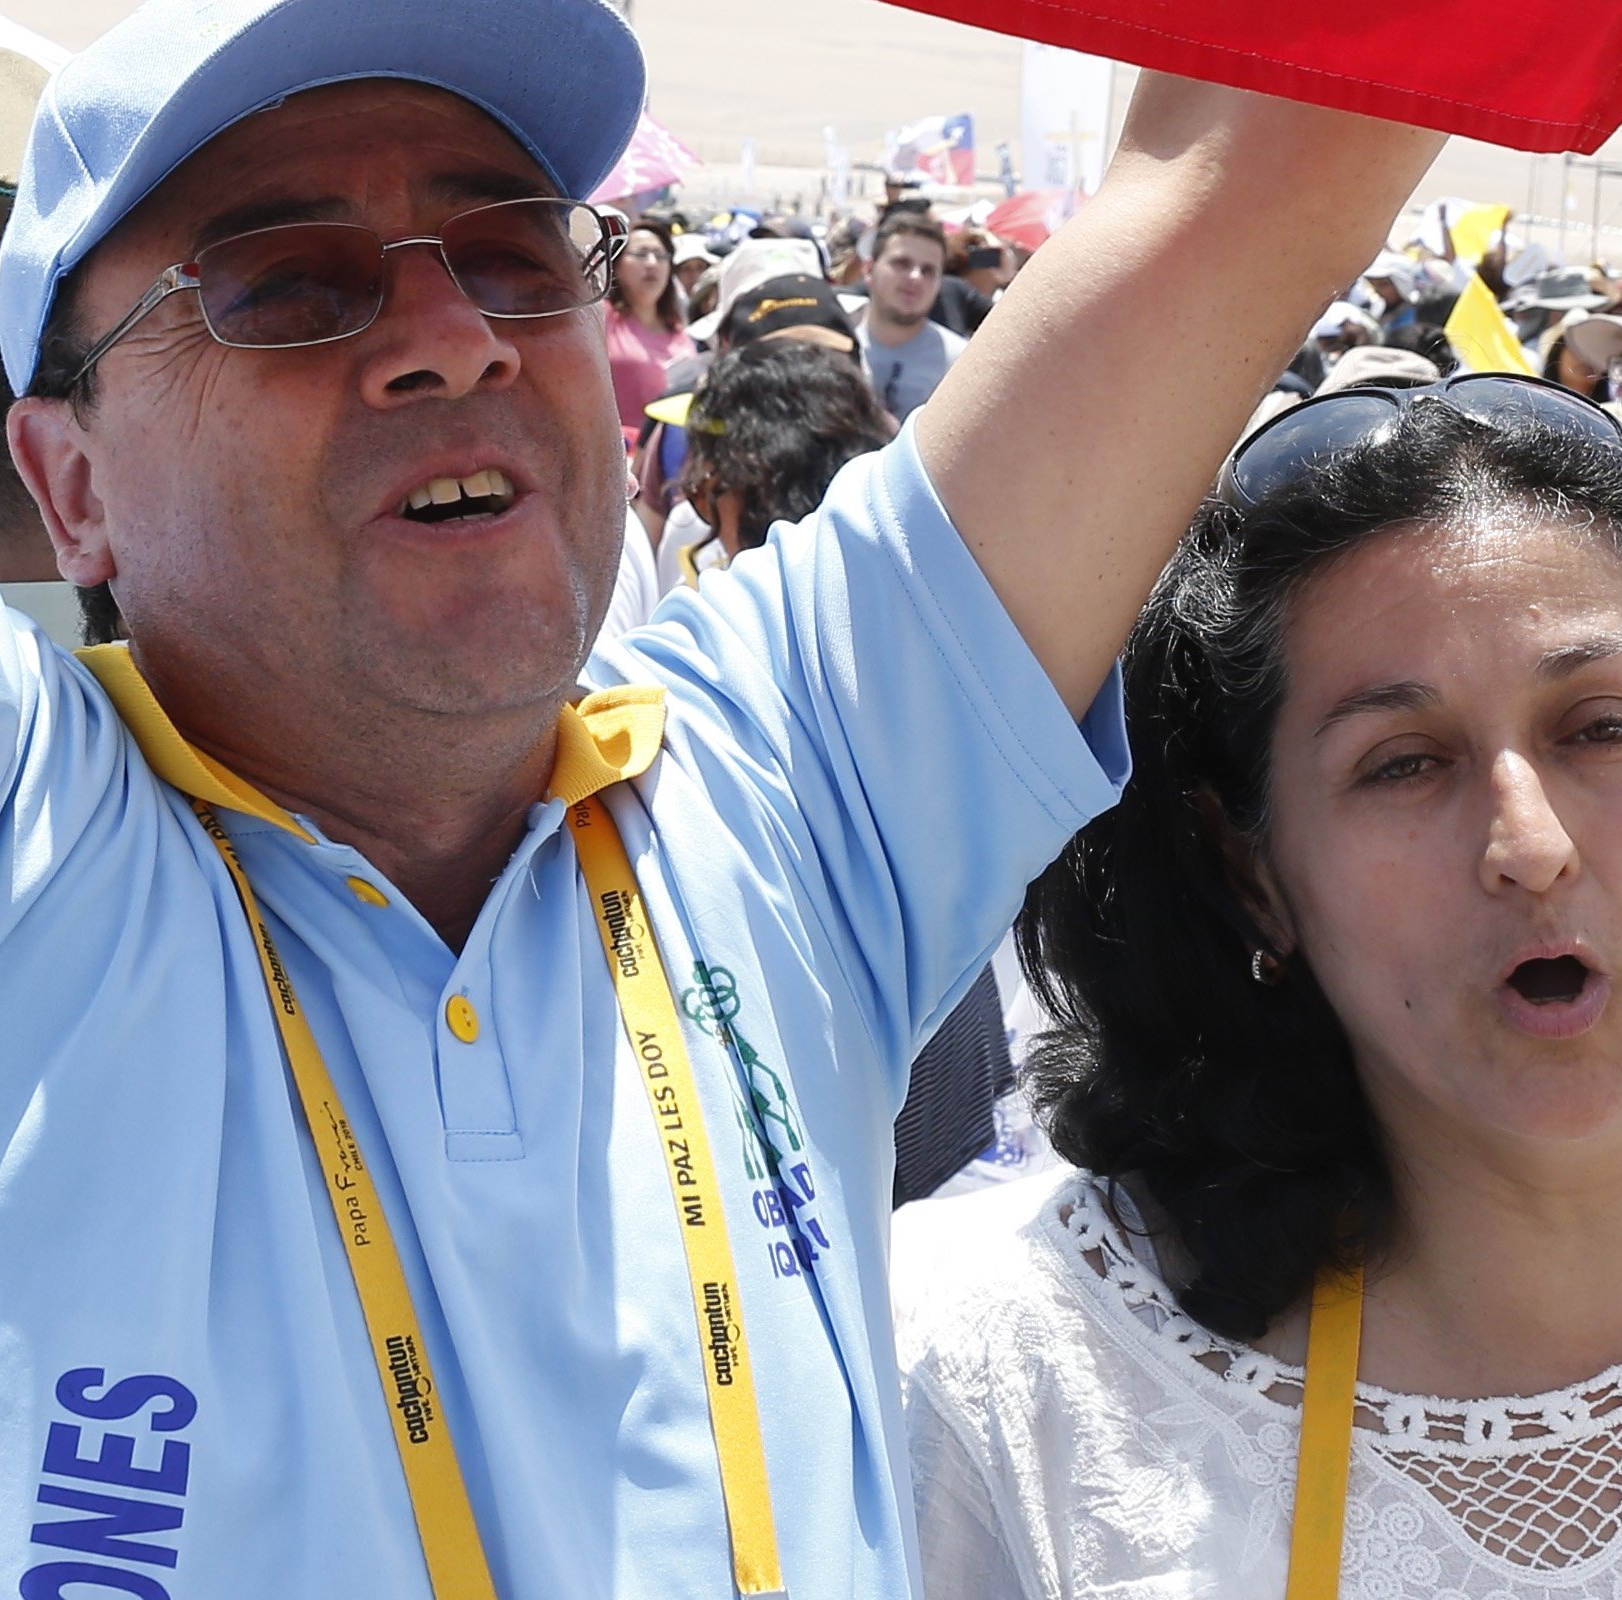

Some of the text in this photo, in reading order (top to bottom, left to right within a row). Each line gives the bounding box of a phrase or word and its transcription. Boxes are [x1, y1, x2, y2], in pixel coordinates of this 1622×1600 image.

[601, 890, 639, 978] cachantun
[339, 1119, 363, 1171] CHILE 2018
[636, 1031, 705, 1227] MI PAZ LES DOY
[346, 1196, 371, 1246] Papa
[703, 1282, 733, 1386] cachantun
[385, 1335, 429, 1444] cachantun
[19, 1367, 197, 1600] ONES
